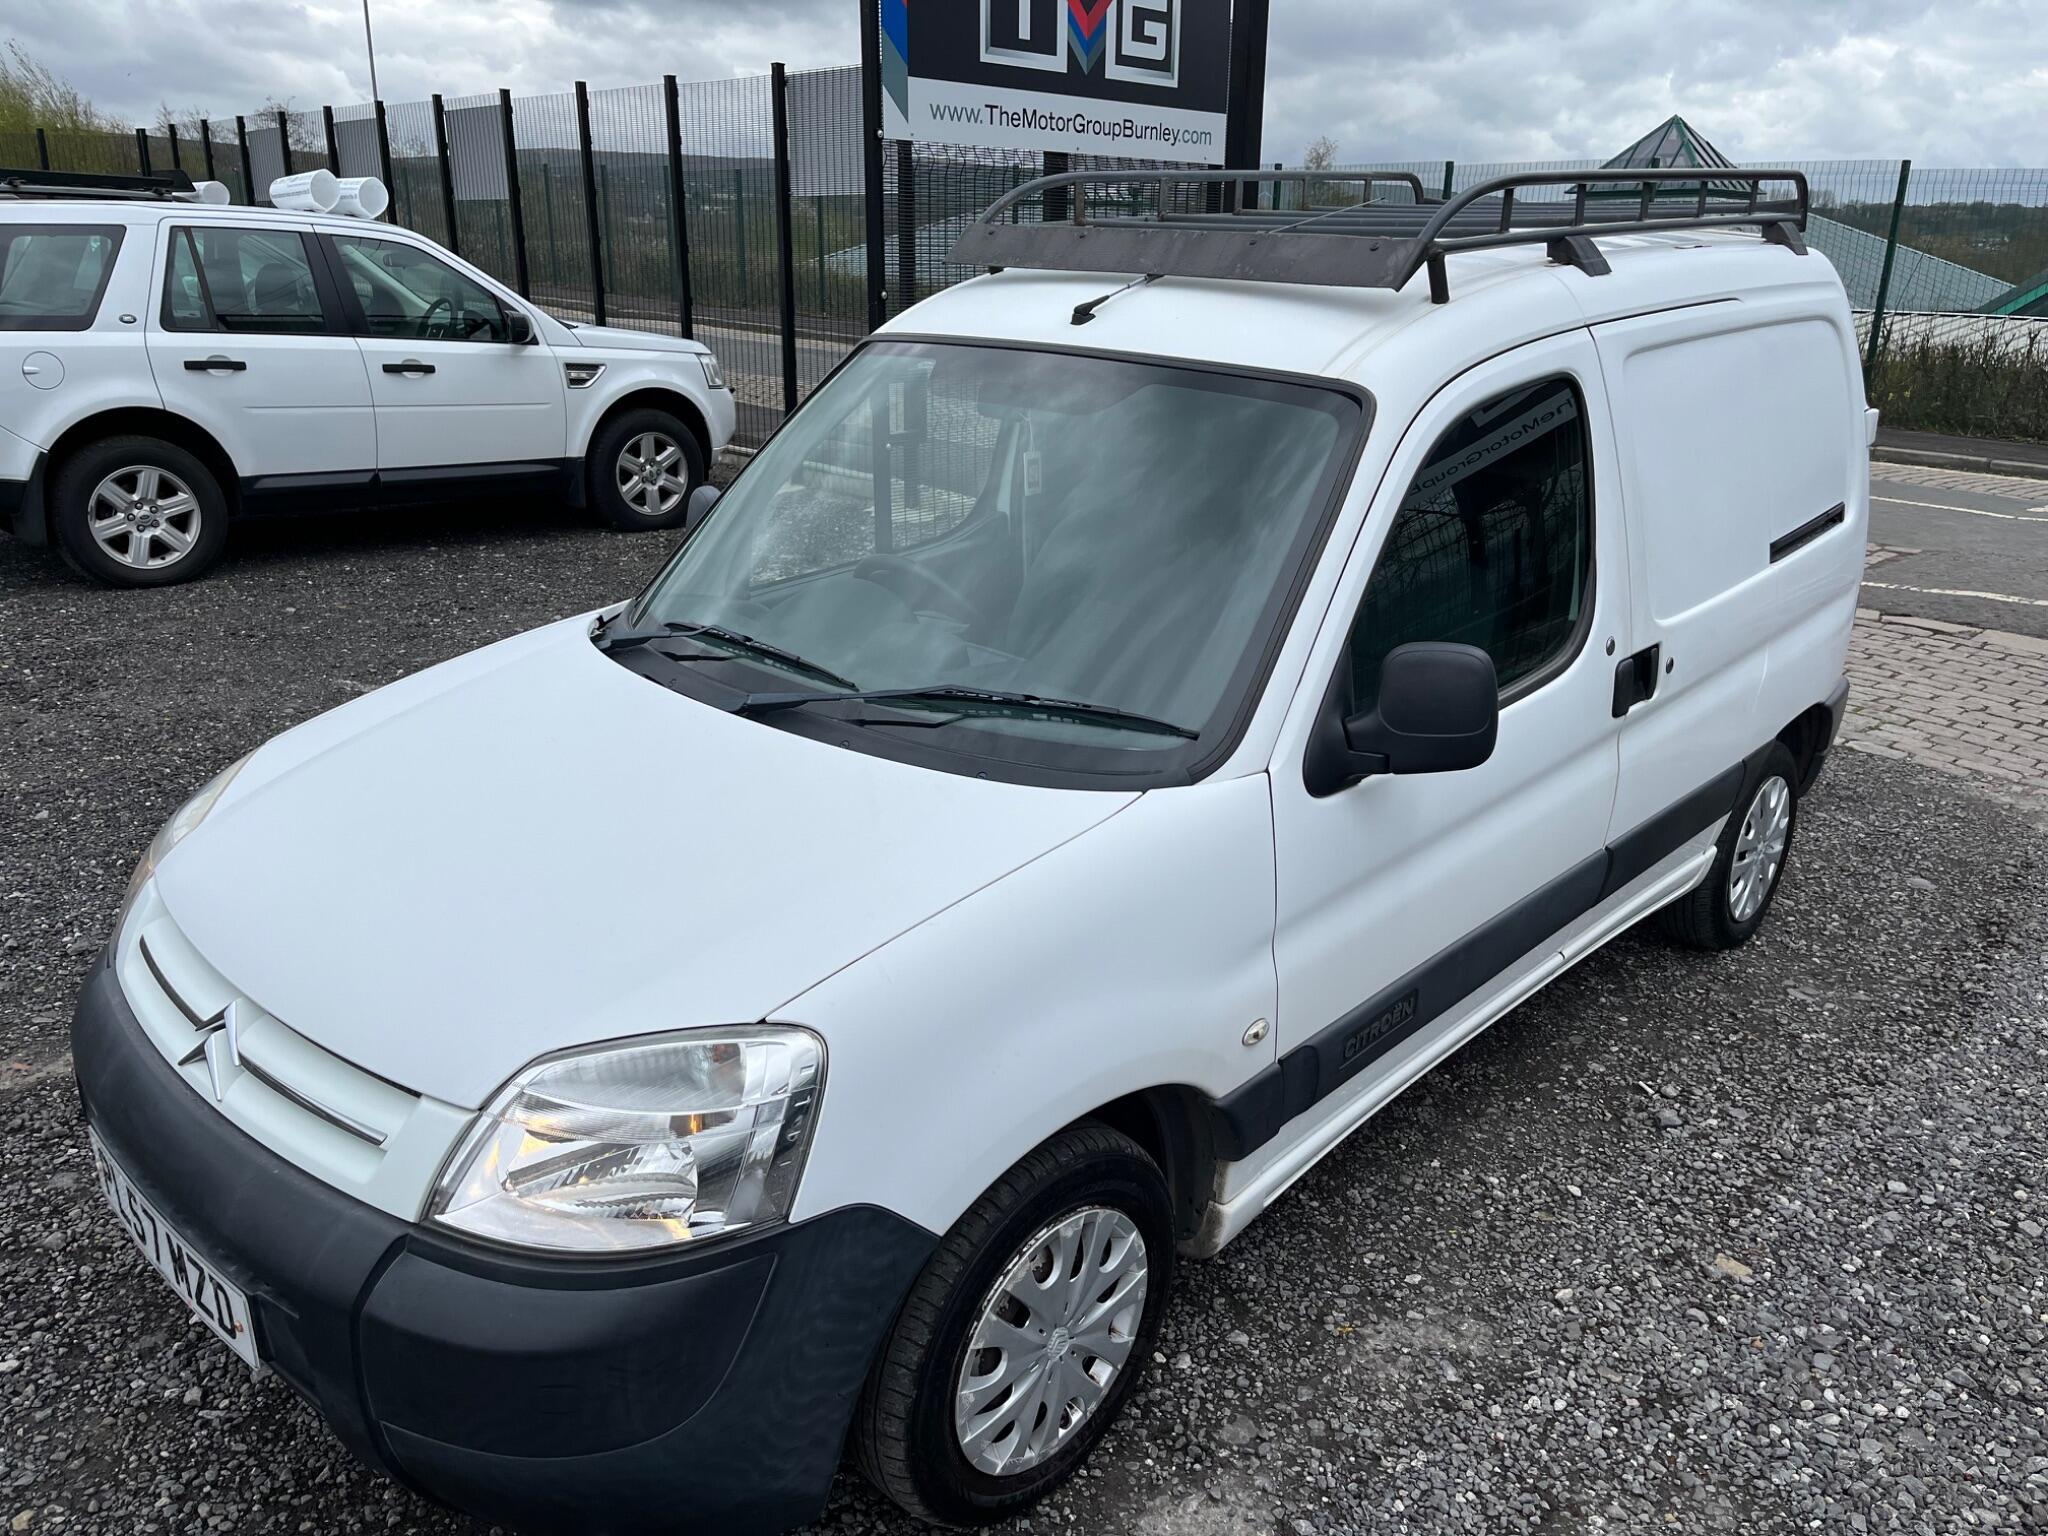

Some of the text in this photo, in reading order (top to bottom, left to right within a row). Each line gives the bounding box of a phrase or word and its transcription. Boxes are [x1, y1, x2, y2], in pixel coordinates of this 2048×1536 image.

[929, 103, 1212, 146] www.TheMotorGroupBurnley.com
[98, 1147, 237, 1340] PL57 MZD
